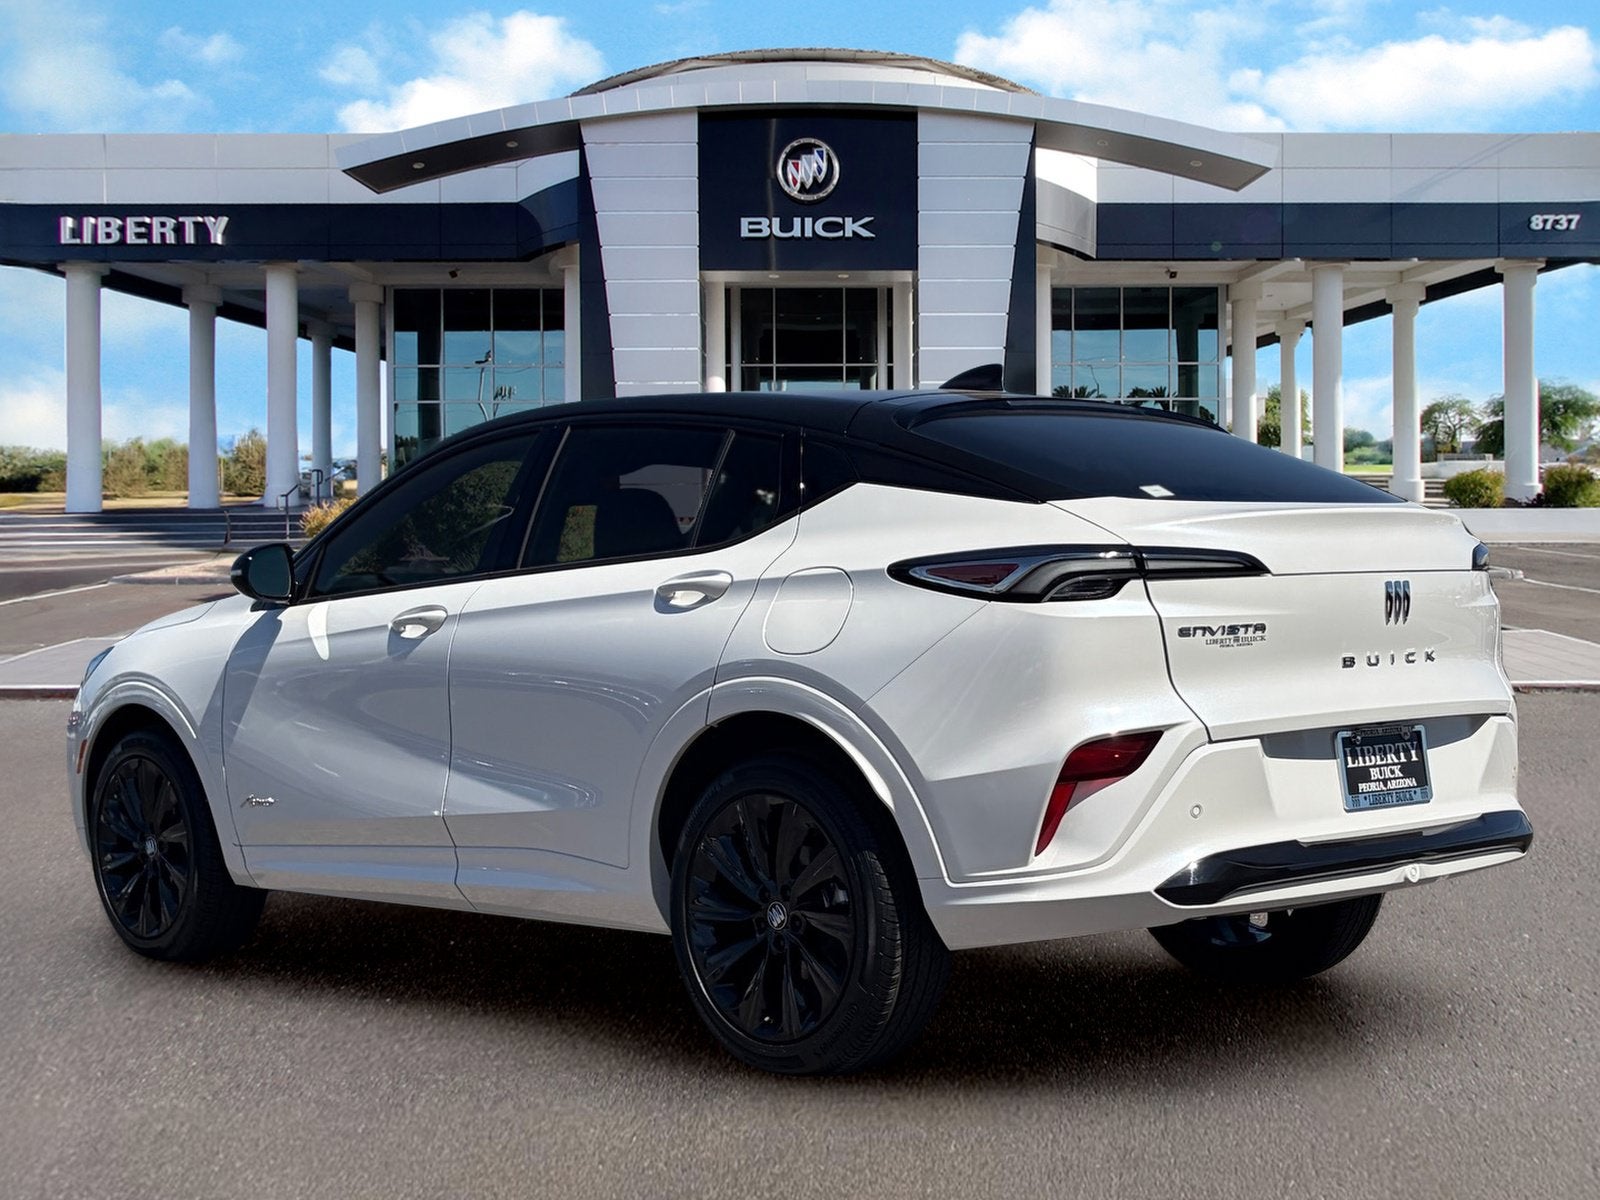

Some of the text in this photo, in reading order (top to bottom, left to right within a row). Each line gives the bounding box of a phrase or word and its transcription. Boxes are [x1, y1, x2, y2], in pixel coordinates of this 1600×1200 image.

[60, 216, 229, 245] LIBERTY
[740, 216, 876, 238] BUICK
[1529, 214, 1581, 231] 8737
[1177, 623, 1267, 638] ENVISTA
[1205, 635, 1266, 646] LIBERTY BUICK
[1341, 650, 1435, 668] BUICK
[1345, 741, 1419, 768] LIBERTY
[1369, 765, 1403, 781] BUICK
[1358, 777, 1417, 793] PEORIA, ARIZONA
[1369, 790, 1414, 806] LIBERTY BUICK
